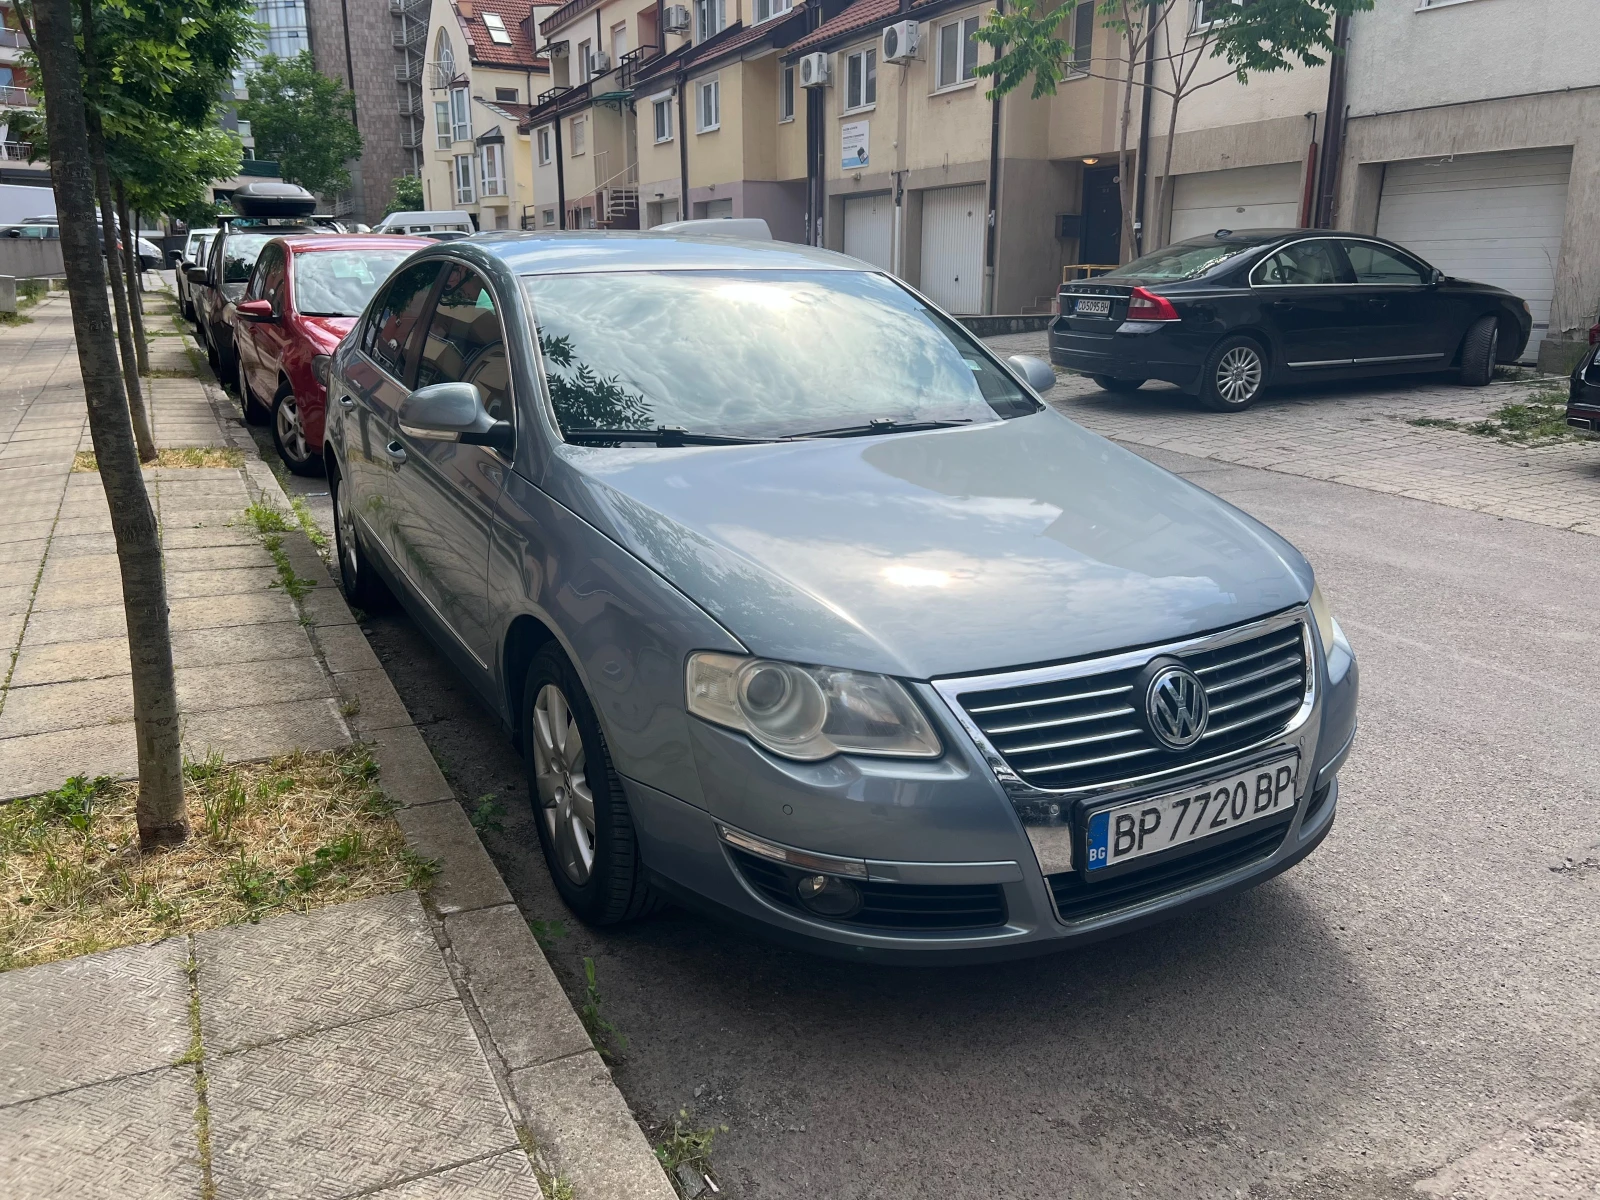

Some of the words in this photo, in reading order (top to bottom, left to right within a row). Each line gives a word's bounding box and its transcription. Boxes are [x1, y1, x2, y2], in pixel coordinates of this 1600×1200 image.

[1152, 670, 1204, 745] VW
[1113, 807, 1162, 858] BP
[1169, 780, 1248, 842] 7720
[1254, 765, 1291, 814] BP
[1090, 847, 1106, 861] BG
